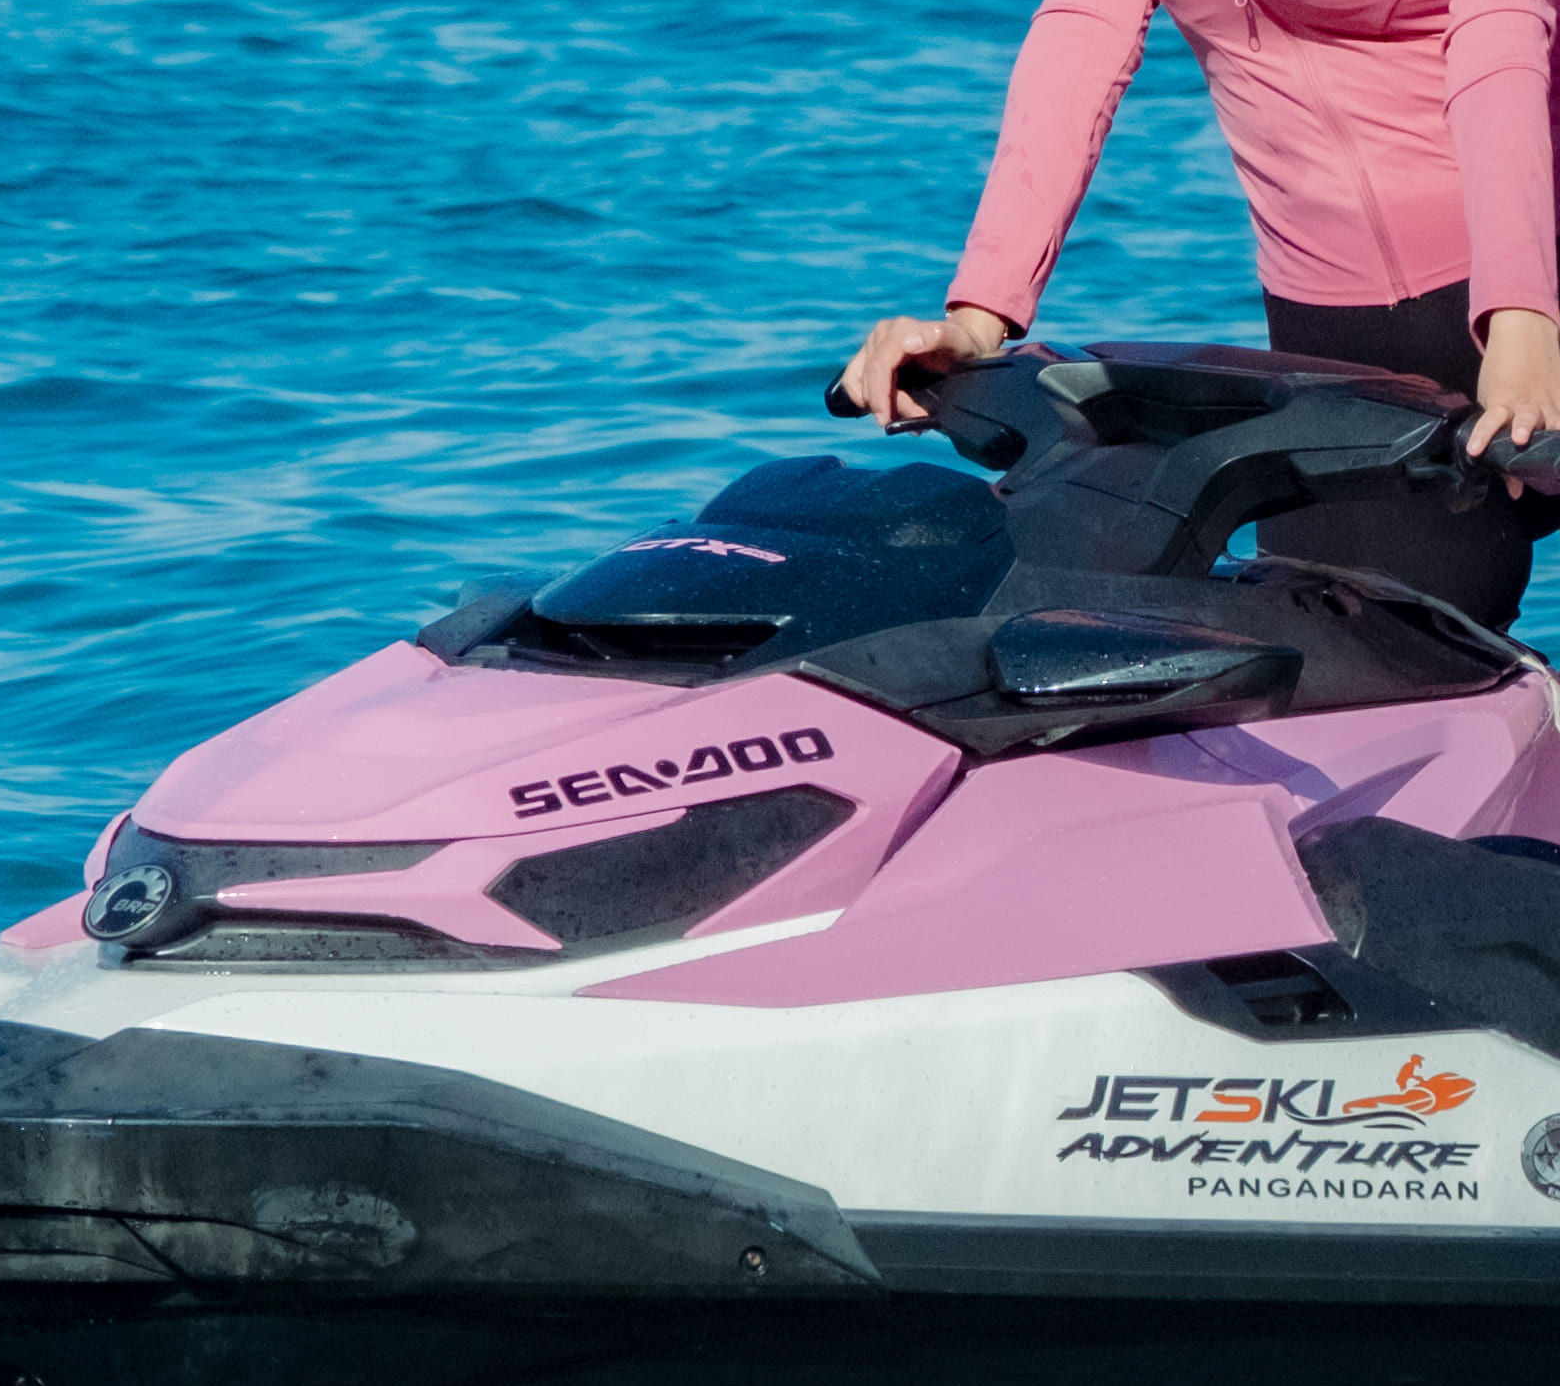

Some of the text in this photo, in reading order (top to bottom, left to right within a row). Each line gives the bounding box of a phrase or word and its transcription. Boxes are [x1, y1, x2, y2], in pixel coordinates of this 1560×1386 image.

[112, 899, 156, 914] BRP
[1056, 1076, 1335, 1123] JETSKI
[1056, 1130, 1480, 1174] ADVENTURE
[1188, 1177, 1479, 1200] PANGANDARAN
